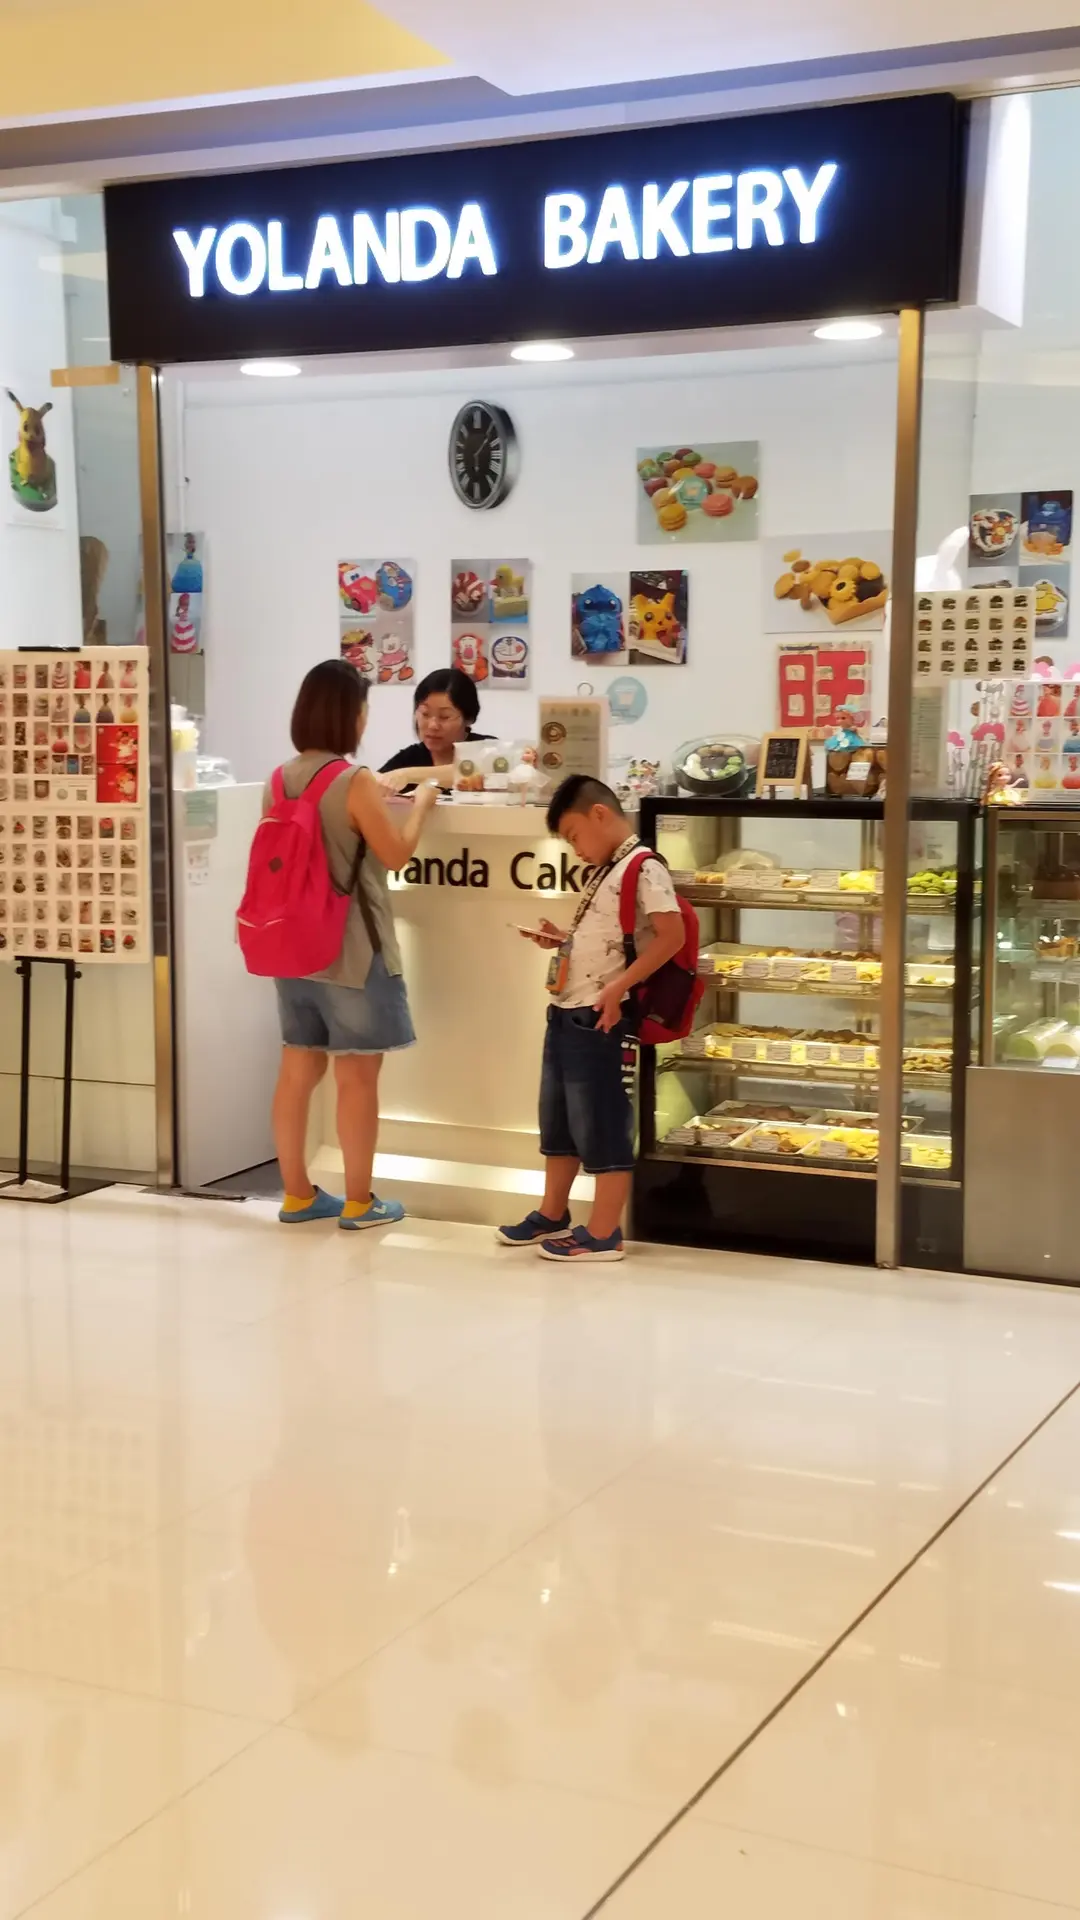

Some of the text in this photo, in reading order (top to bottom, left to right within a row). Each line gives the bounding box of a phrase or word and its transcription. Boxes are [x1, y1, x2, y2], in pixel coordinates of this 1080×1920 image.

[173, 163, 838, 298] YOLANDA BAKERY
[779, 650, 866, 728] 旺
